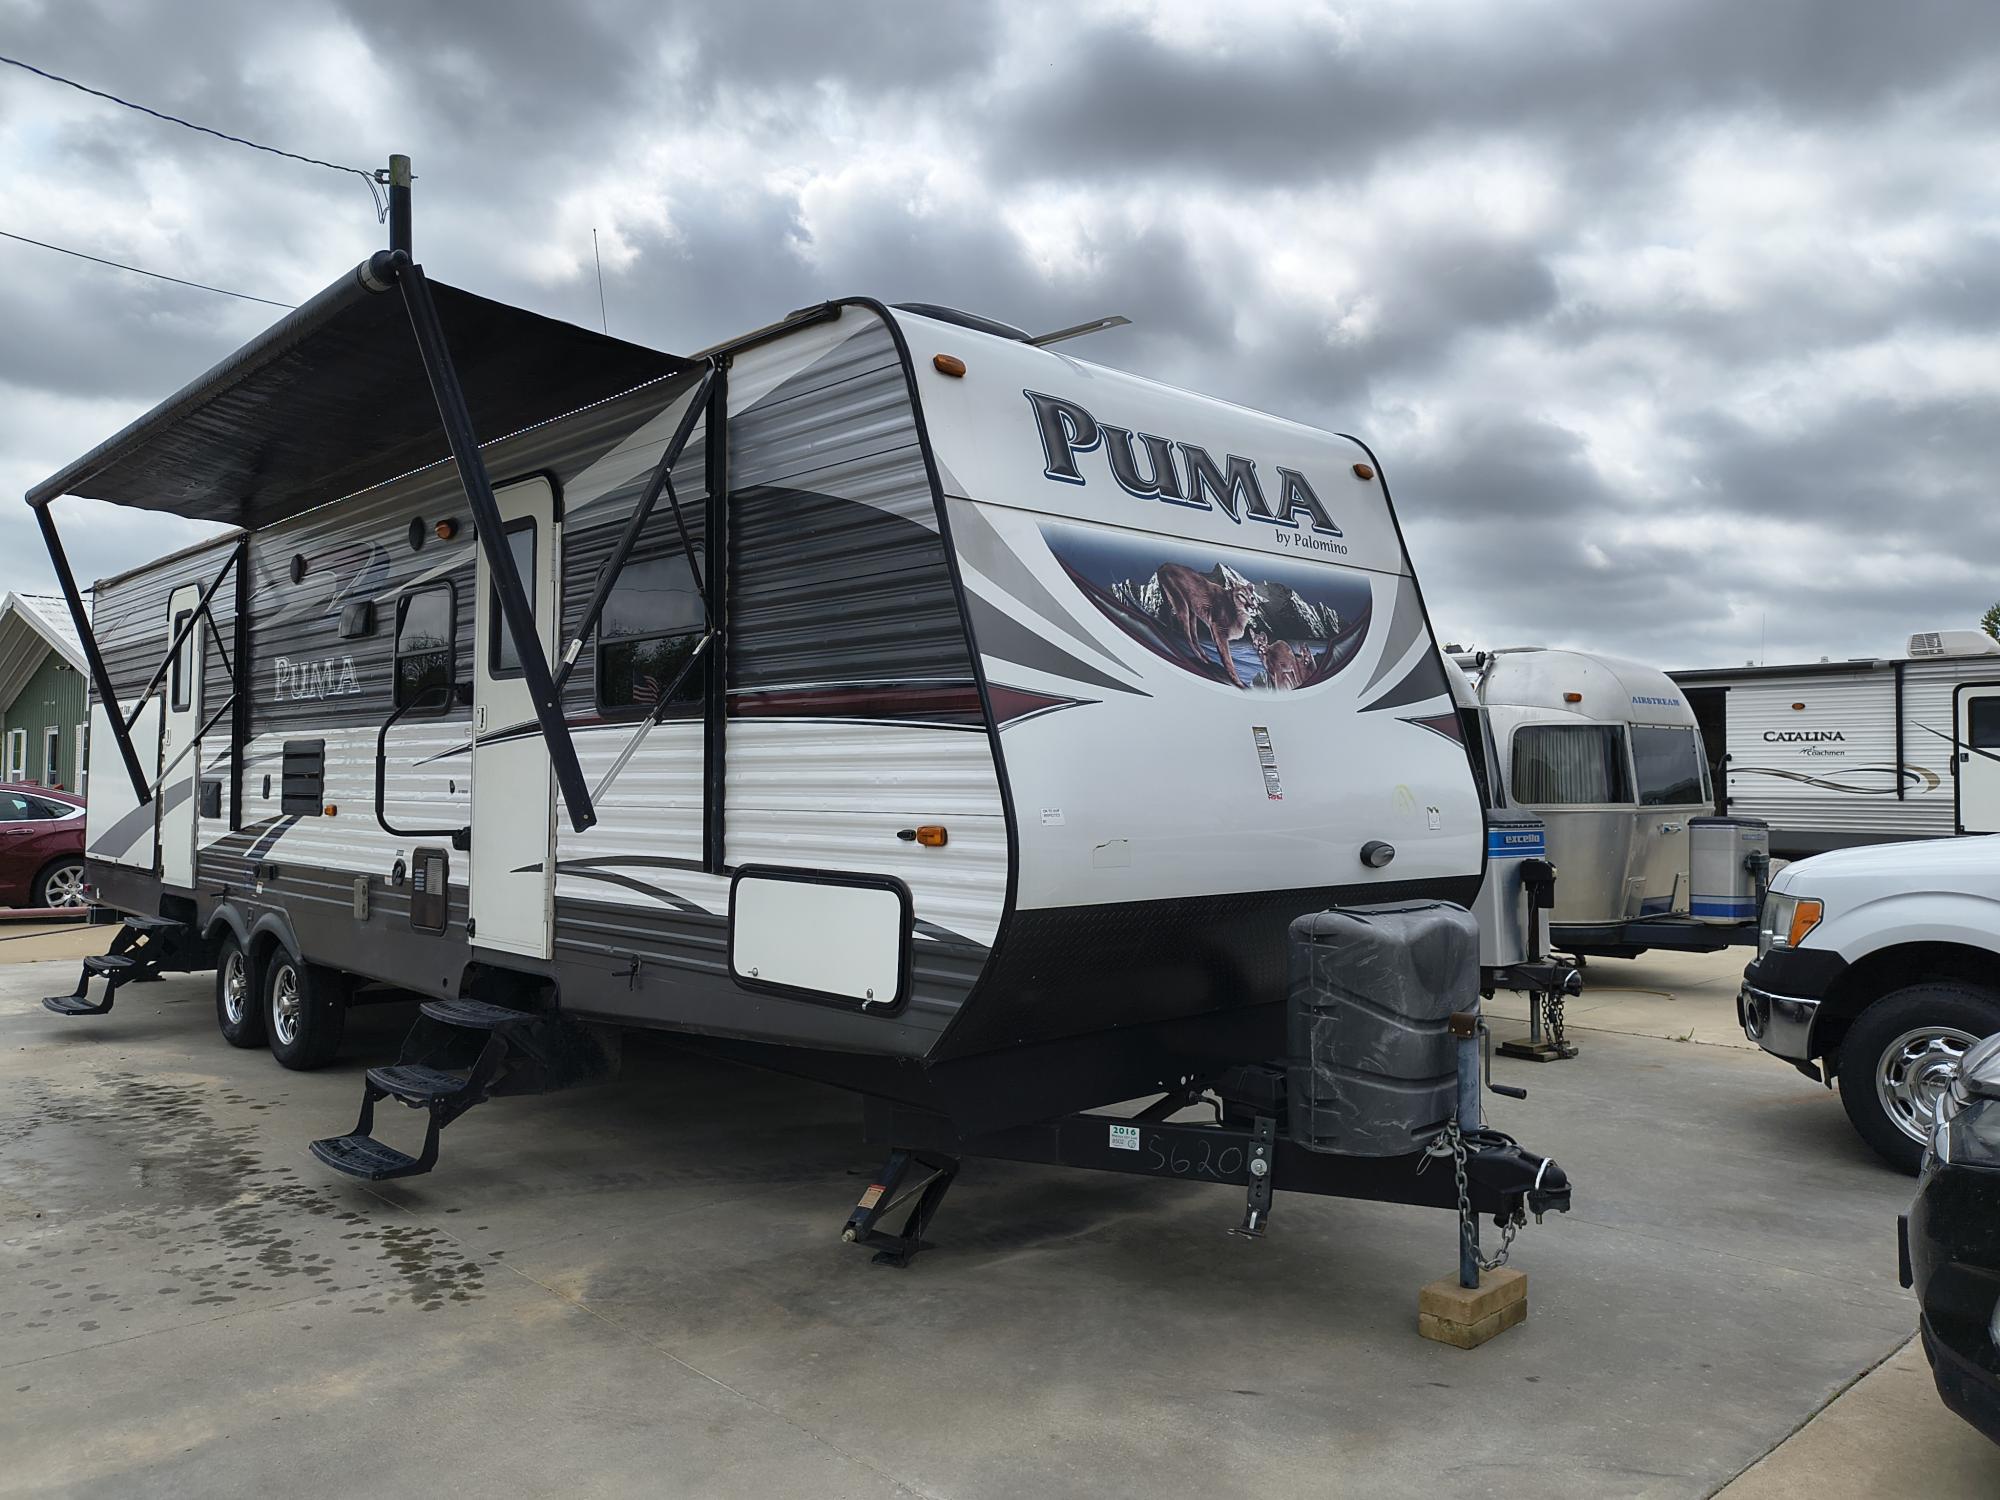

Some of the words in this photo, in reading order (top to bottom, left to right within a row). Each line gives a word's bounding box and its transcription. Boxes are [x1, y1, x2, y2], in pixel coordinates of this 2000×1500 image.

[1023, 389, 1343, 537] PUMA
[1275, 529, 1291, 547] by
[1294, 533, 1348, 555] Palomino
[274, 655, 361, 700] PUMA
[1632, 696, 1680, 706] AIRSTREAM
[1763, 731, 1846, 742] CATALINA
[1112, 1126, 1137, 1136] 2016
